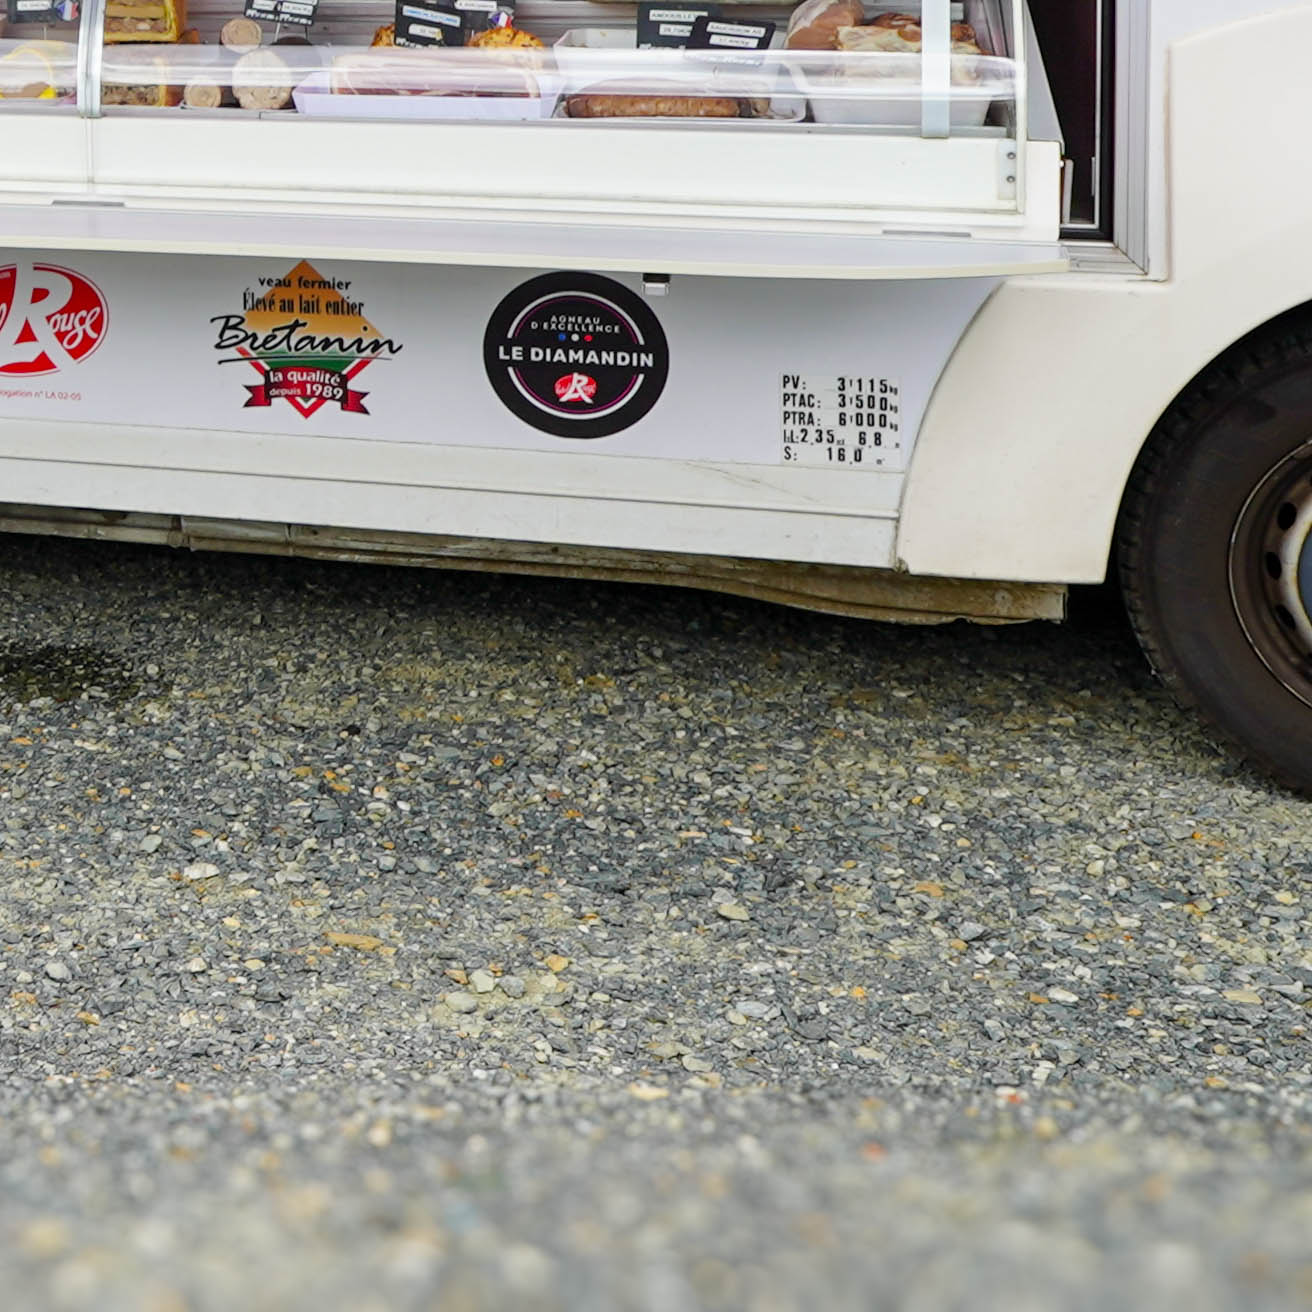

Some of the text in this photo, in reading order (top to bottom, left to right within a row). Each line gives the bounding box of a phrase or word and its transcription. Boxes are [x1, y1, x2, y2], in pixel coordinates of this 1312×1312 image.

[258, 275, 352, 290] veau fermier
[242, 287, 365, 317] Élevé au lait entier
[550, 314, 602, 325] AGNEAU
[210, 314, 404, 355] Bretanin
[498, 345, 654, 368] LE DIAMANDIN
[269, 370, 341, 386] la qualité
[269, 383, 344, 400] depuis 1989
[783, 392, 822, 409] PTAC:
[783, 410, 822, 427] PTRA:
